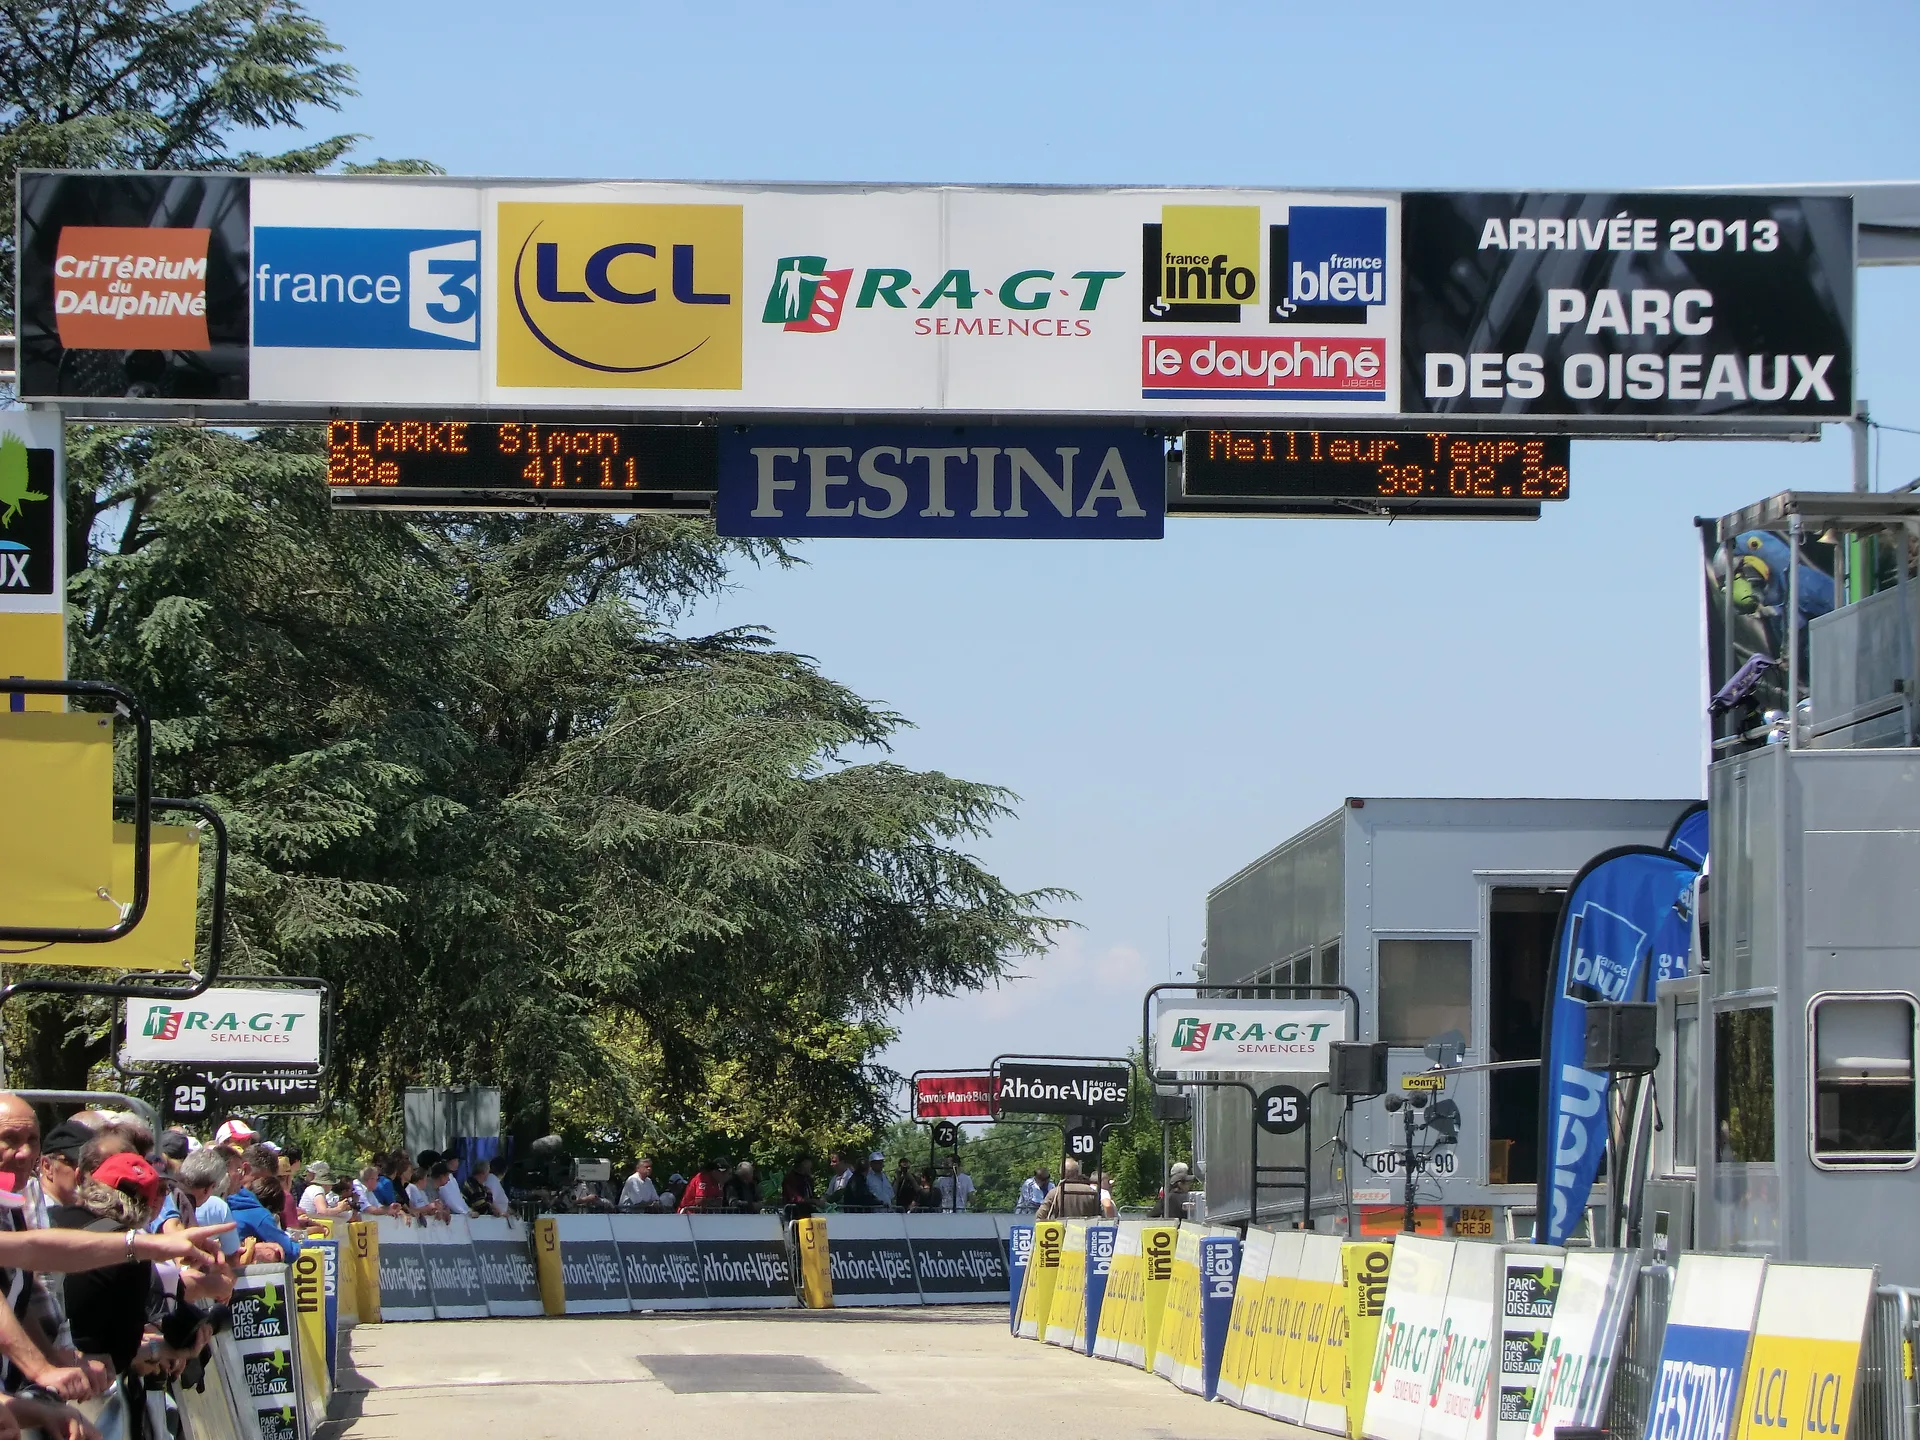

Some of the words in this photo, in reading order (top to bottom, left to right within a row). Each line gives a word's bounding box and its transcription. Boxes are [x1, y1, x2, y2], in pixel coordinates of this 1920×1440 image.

[1478, 211, 1657, 251] ARRIVÉE
[1669, 219, 1779, 252] 2013
[1165, 252, 1209, 265] france
[1330, 253, 1382, 269] france
[536, 242, 731, 305] LCL
[1165, 255, 1256, 300] info
[1292, 261, 1382, 301] bleu
[108, 280, 132, 294] du
[256, 264, 401, 304] france
[426, 259, 477, 324] 3
[1548, 289, 1713, 335] PARC
[915, 317, 1092, 337] SEMENCES
[1148, 340, 1182, 375] le
[1190, 341, 1380, 386] dauphiné
[1425, 352, 1545, 399] DES
[1563, 353, 1834, 401] OISEAUX
[328, 420, 468, 451] CLARKE
[499, 423, 619, 454] Simon
[1209, 430, 1399, 461] Meilleur
[1427, 432, 1545, 462] Temps
[328, 453, 399, 484] 28e
[523, 456, 639, 487] 41:11
[750, 446, 1147, 518] FESTINA
[1377, 465, 1569, 495] 38:02.29
[211, 1033, 290, 1043] SEMENCES
[1237, 1043, 1315, 1053] SEMENCES
[174, 1085, 206, 1112] 25
[1267, 1096, 1298, 1122] 25
[939, 1127, 953, 1142] 75
[1072, 1135, 1094, 1154] 50
[1377, 1153, 1396, 1173] 60
[1435, 1153, 1454, 1173] 90
[357, 1226, 367, 1258] LCL
[545, 1222, 554, 1251] LCL
[806, 1222, 815, 1249] LCL
[1040, 1228, 1060, 1267] info
[1090, 1231, 1098, 1256] france
[1093, 1231, 1113, 1275] bleu
[1147, 1232, 1171, 1280] info
[1205, 1244, 1214, 1275] france
[1210, 1243, 1234, 1297] bleu
[1357, 1251, 1389, 1316] info
[1508, 1277, 1536, 1291] PARC
[231, 1299, 260, 1315] PARC
[1357, 1285, 1366, 1317] france
[1508, 1290, 1529, 1303] DES
[232, 1312, 254, 1326] DES
[1506, 1303, 1552, 1316] OISEAUX
[233, 1321, 281, 1339] OISEAUX
[1504, 1340, 1529, 1352] PARC
[1504, 1351, 1522, 1362] DES
[245, 1361, 271, 1375] PARC
[247, 1373, 265, 1384] DES
[1503, 1361, 1542, 1374] OISEAUX
[249, 1381, 288, 1397] OISEAUX
[1502, 1394, 1521, 1403] PARC
[1648, 1360, 1734, 1440] FESTINA
[1754, 1367, 1787, 1427] LCL
[1807, 1372, 1841, 1434] LCL
[1500, 1411, 1529, 1420] OISEAU
[1501, 1403, 1516, 1411] DES
[260, 1416, 280, 1426] PARC
[261, 1424, 276, 1434] DES
